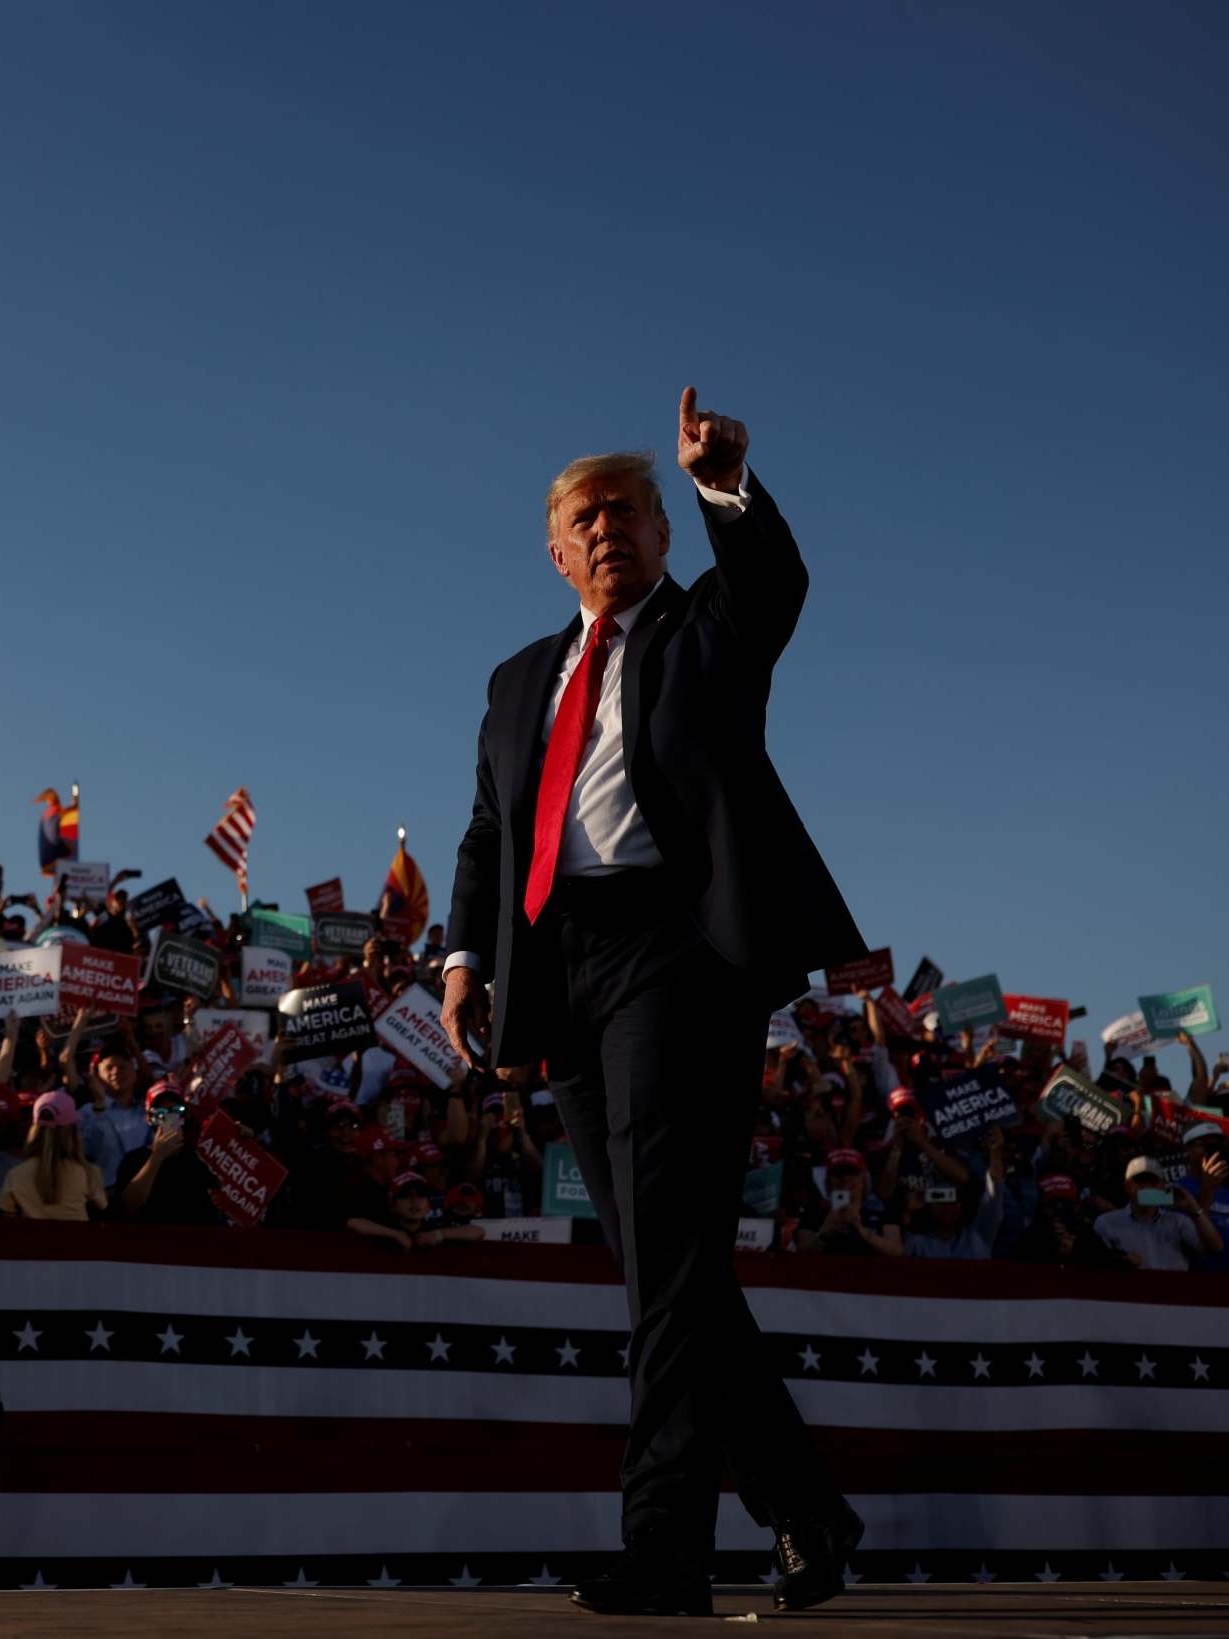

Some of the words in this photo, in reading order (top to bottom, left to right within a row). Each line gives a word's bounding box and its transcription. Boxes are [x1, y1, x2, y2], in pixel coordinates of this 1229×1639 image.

[82, 955, 114, 971] MAKE
[61, 965, 134, 993] AMERICA
[7, 990, 54, 1004] AGAIN
[97, 990, 134, 1006] AGAIN
[303, 993, 339, 1012] MAKE
[285, 1004, 367, 1034] AMERICA
[386, 1015, 422, 1047] GREAT
[1009, 1011, 1063, 1029] MERICA
[297, 1031, 327, 1047] REAT
[330, 1024, 371, 1041] AGAIN
[396, 1006, 463, 1067] AMERICA
[945, 1079, 981, 1100] MAKE
[934, 1086, 1010, 1126] AMERICA
[941, 1114, 981, 1139] GREAT
[983, 1103, 1017, 1122] AGAIN
[228, 1138, 259, 1170] MAKE
[198, 1138, 267, 1205] AMERICA
[221, 1184, 260, 1217] AGAIN
[501, 1230, 539, 1241] MAKE
[739, 1231, 757, 1242] AKE
